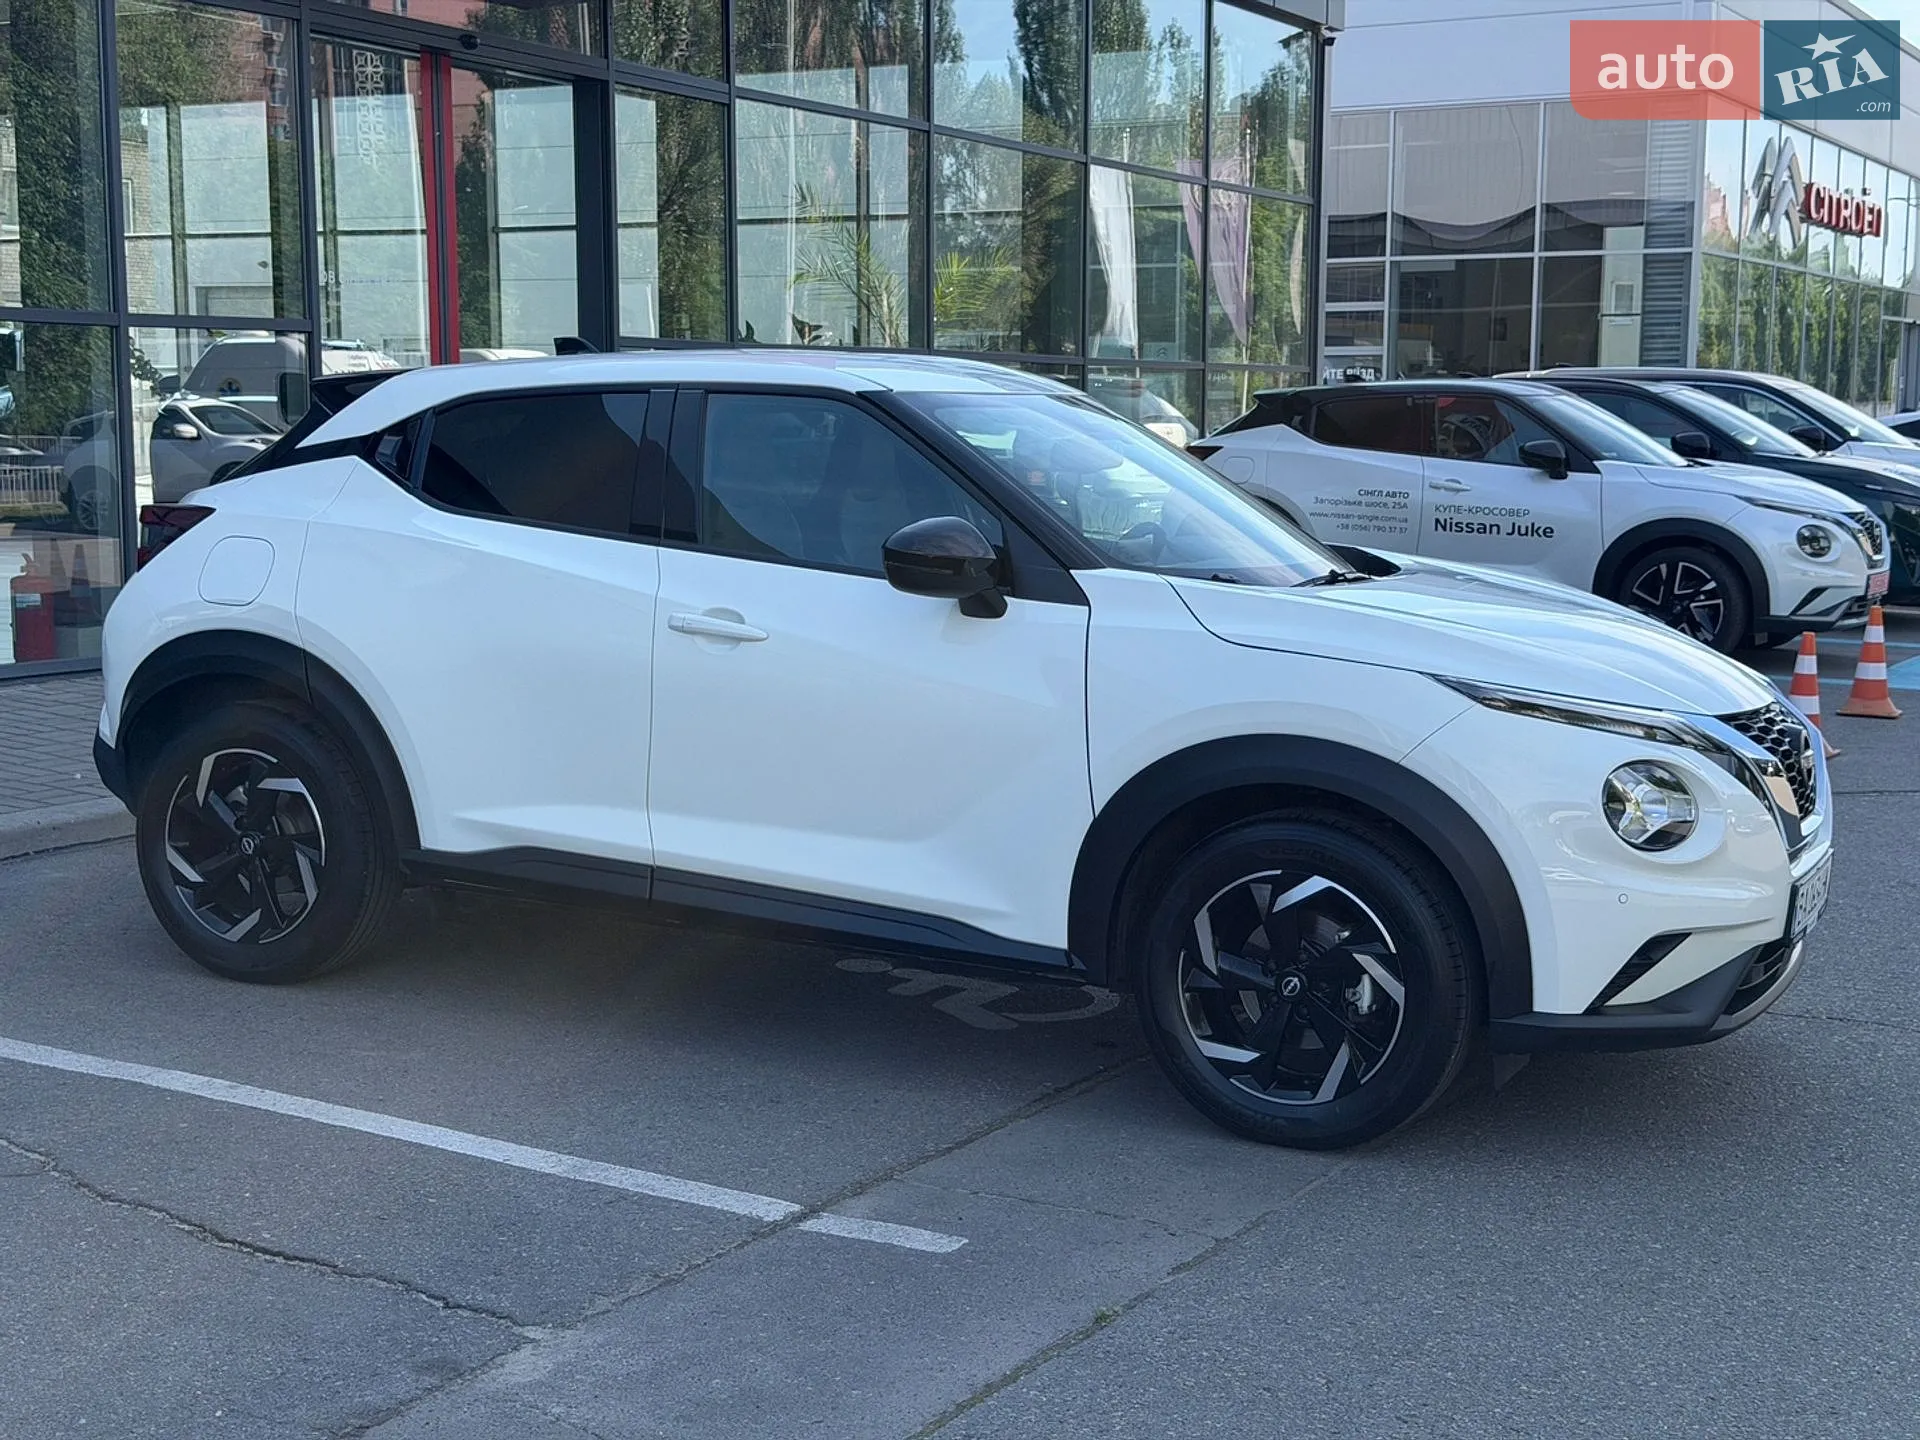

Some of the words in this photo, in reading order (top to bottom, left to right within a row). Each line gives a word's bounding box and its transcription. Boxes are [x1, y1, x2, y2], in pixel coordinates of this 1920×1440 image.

[1385, 490, 1410, 500] АВТО
[1434, 504, 1531, 518] КУПЕ-КРОСОВЕР
[1434, 517, 1501, 535] Nissan
[1506, 521, 1555, 539] Juke
